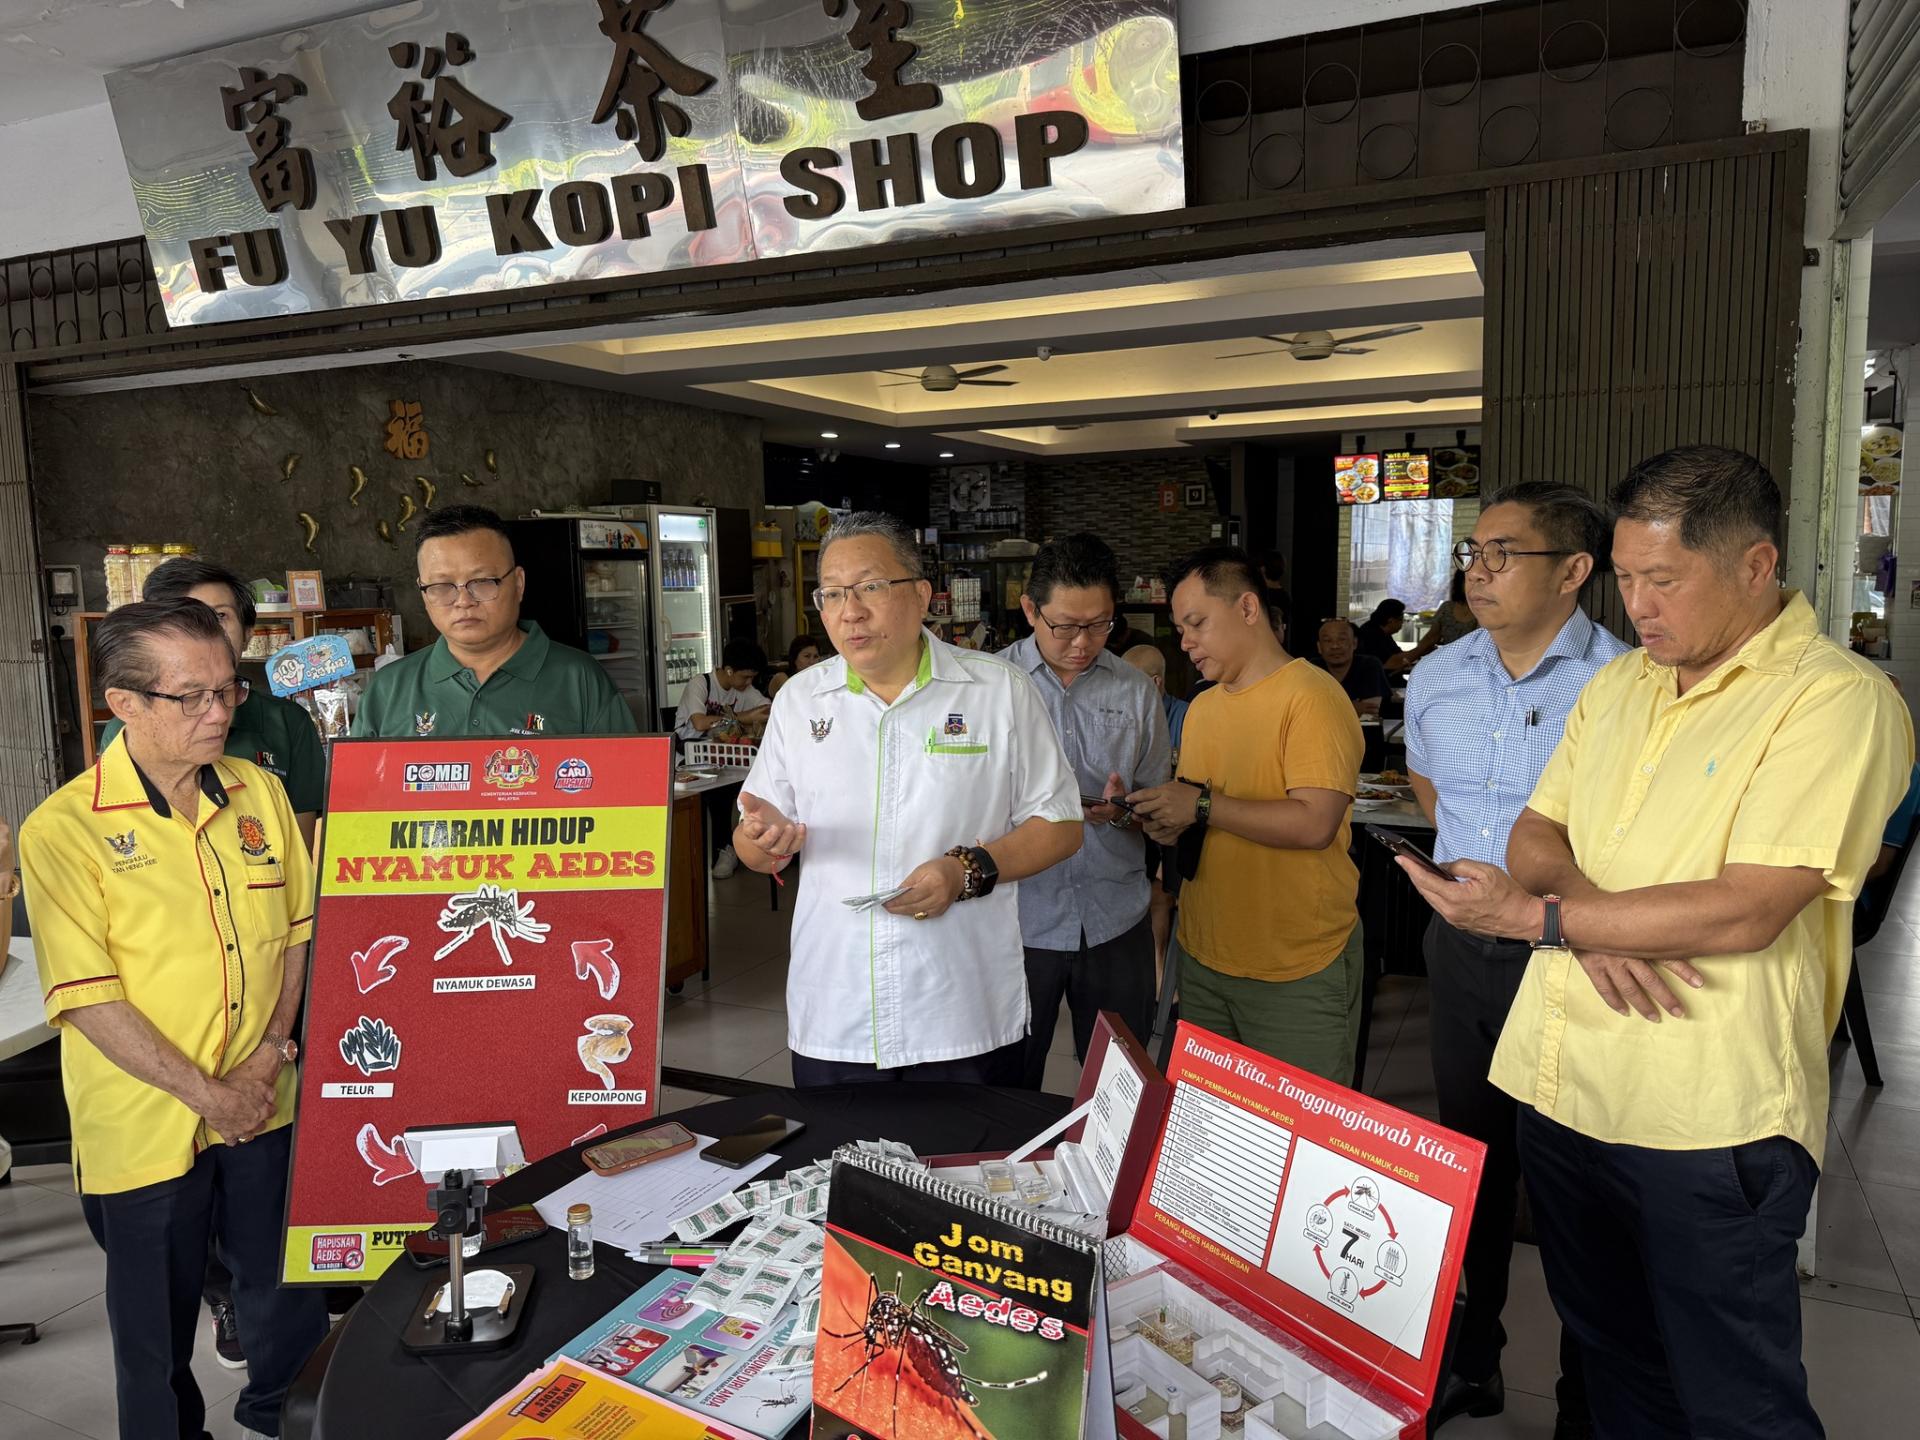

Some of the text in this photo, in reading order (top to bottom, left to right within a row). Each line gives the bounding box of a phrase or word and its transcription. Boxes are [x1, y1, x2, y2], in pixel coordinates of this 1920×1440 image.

[188, 110, 1090, 293] FU YU KOPI SHOP
[1163, 490, 1174, 506] B
[406, 764, 468, 781] COMBI
[558, 768, 586, 778] CARI
[390, 816, 595, 849] KITARAN HIDUP
[336, 850, 656, 883] NYAMUK AEDES
[436, 976, 533, 991] NYAMUK DEWASA
[340, 1085, 374, 1096] TELUR
[570, 1091, 642, 1103] KEPOMPONG
[1181, 1069, 1295, 1126] TEMPAT PEMBIAKAN NYAMUK AEDES
[1184, 1037, 1469, 1174] Rumah Kita... Tanggungjawab Kita...
[1329, 1136, 1420, 1184] KITARAN NYAMUK AEDES
[316, 1249, 342, 1261] AEDES
[317, 1236, 355, 1248] HAPUSKAN
[940, 1223, 1023, 1262] Jom
[1154, 1211, 1180, 1231] PERANGI
[1180, 1226, 1201, 1245] AEDES
[1200, 1239, 1250, 1274] HABIS-HABISAN
[1340, 1227, 1359, 1259] 7
[913, 1242, 1072, 1302] Ganyang
[1345, 1254, 1365, 1269] HARI
[925, 1281, 1065, 1340] Aedes
[706, 1346, 778, 1408] LINDUNGI DIRI ANDA
[534, 1385, 560, 1408] AEDES
[537, 1382, 578, 1418] HAPUSKAN
